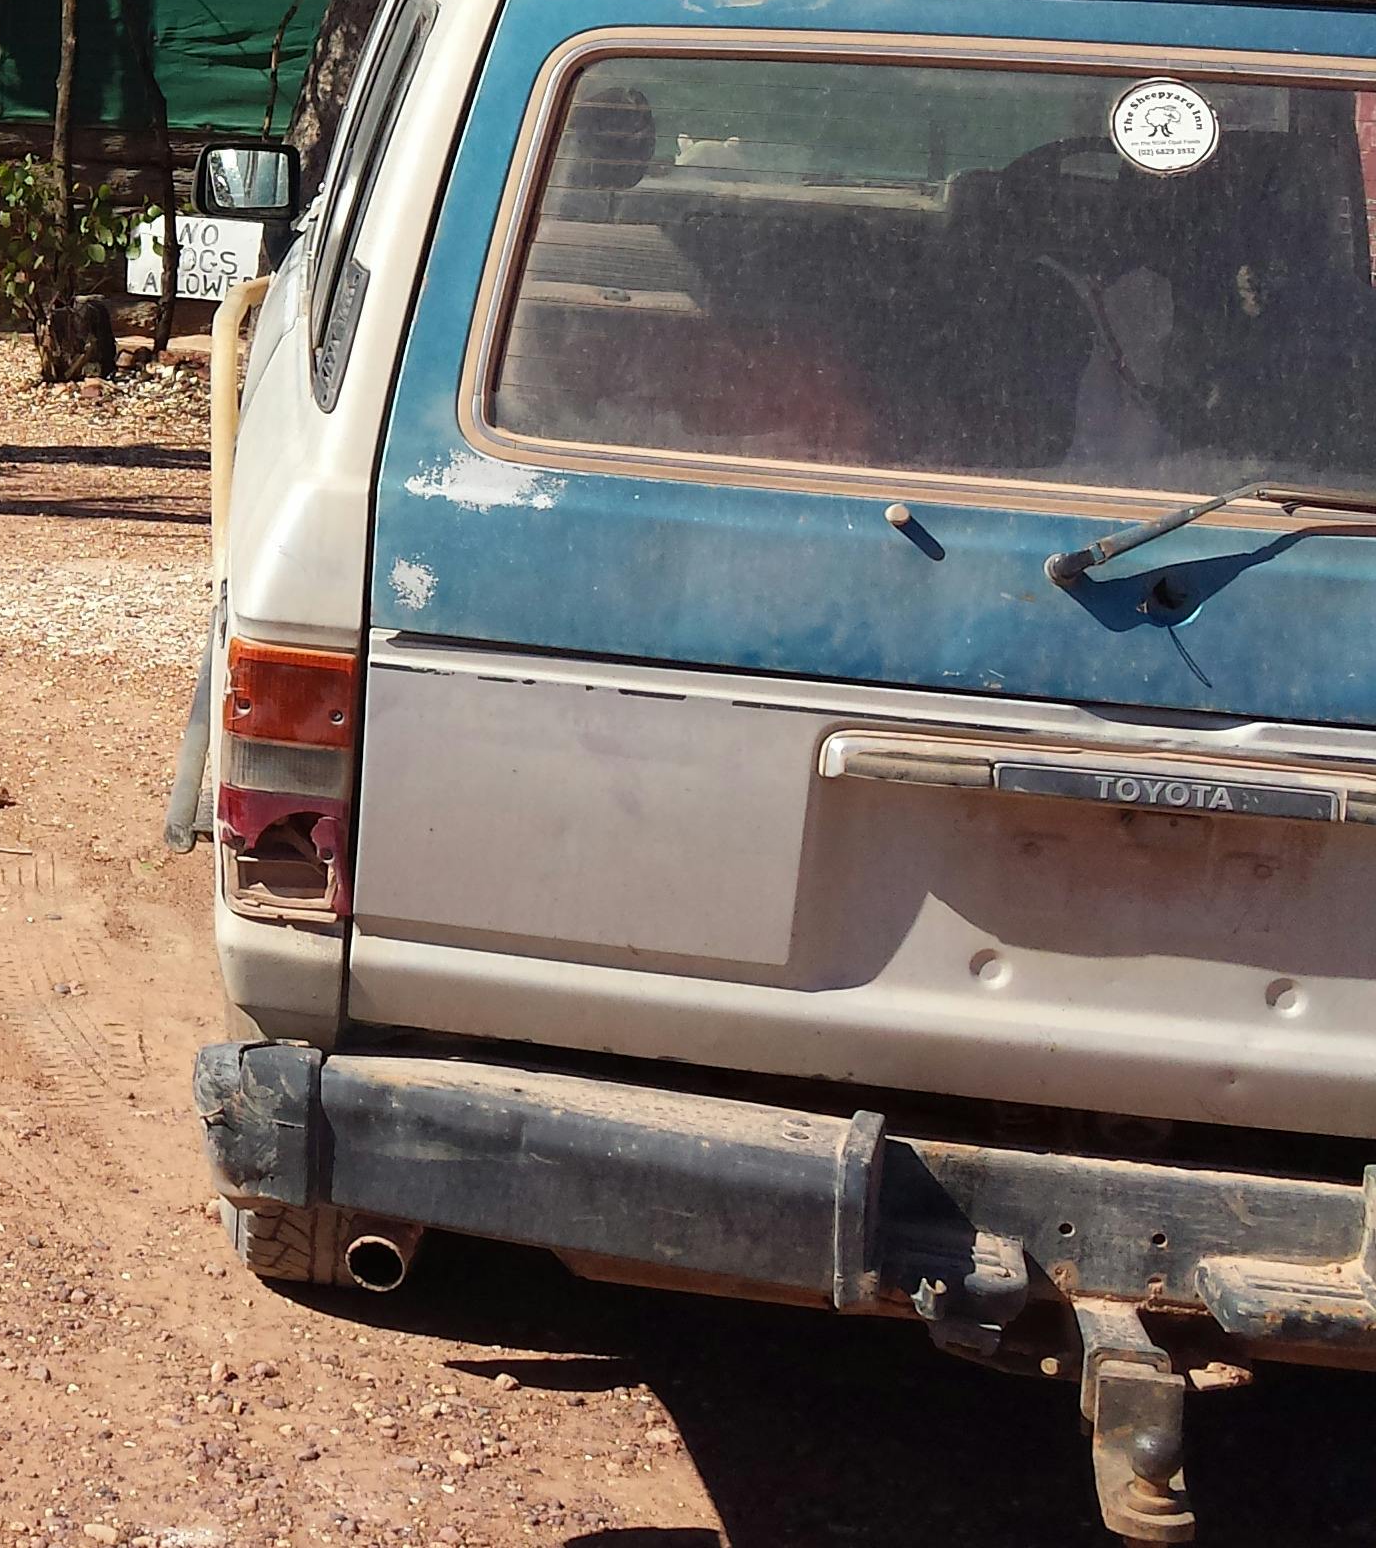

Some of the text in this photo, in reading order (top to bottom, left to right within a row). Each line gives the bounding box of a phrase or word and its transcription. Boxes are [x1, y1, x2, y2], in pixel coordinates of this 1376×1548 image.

[1123, 91, 1204, 134] The Sheepyard Inn
[178, 222, 219, 247] NO
[179, 247, 238, 275] OGS
[1094, 775, 1235, 812] TOYOTA
